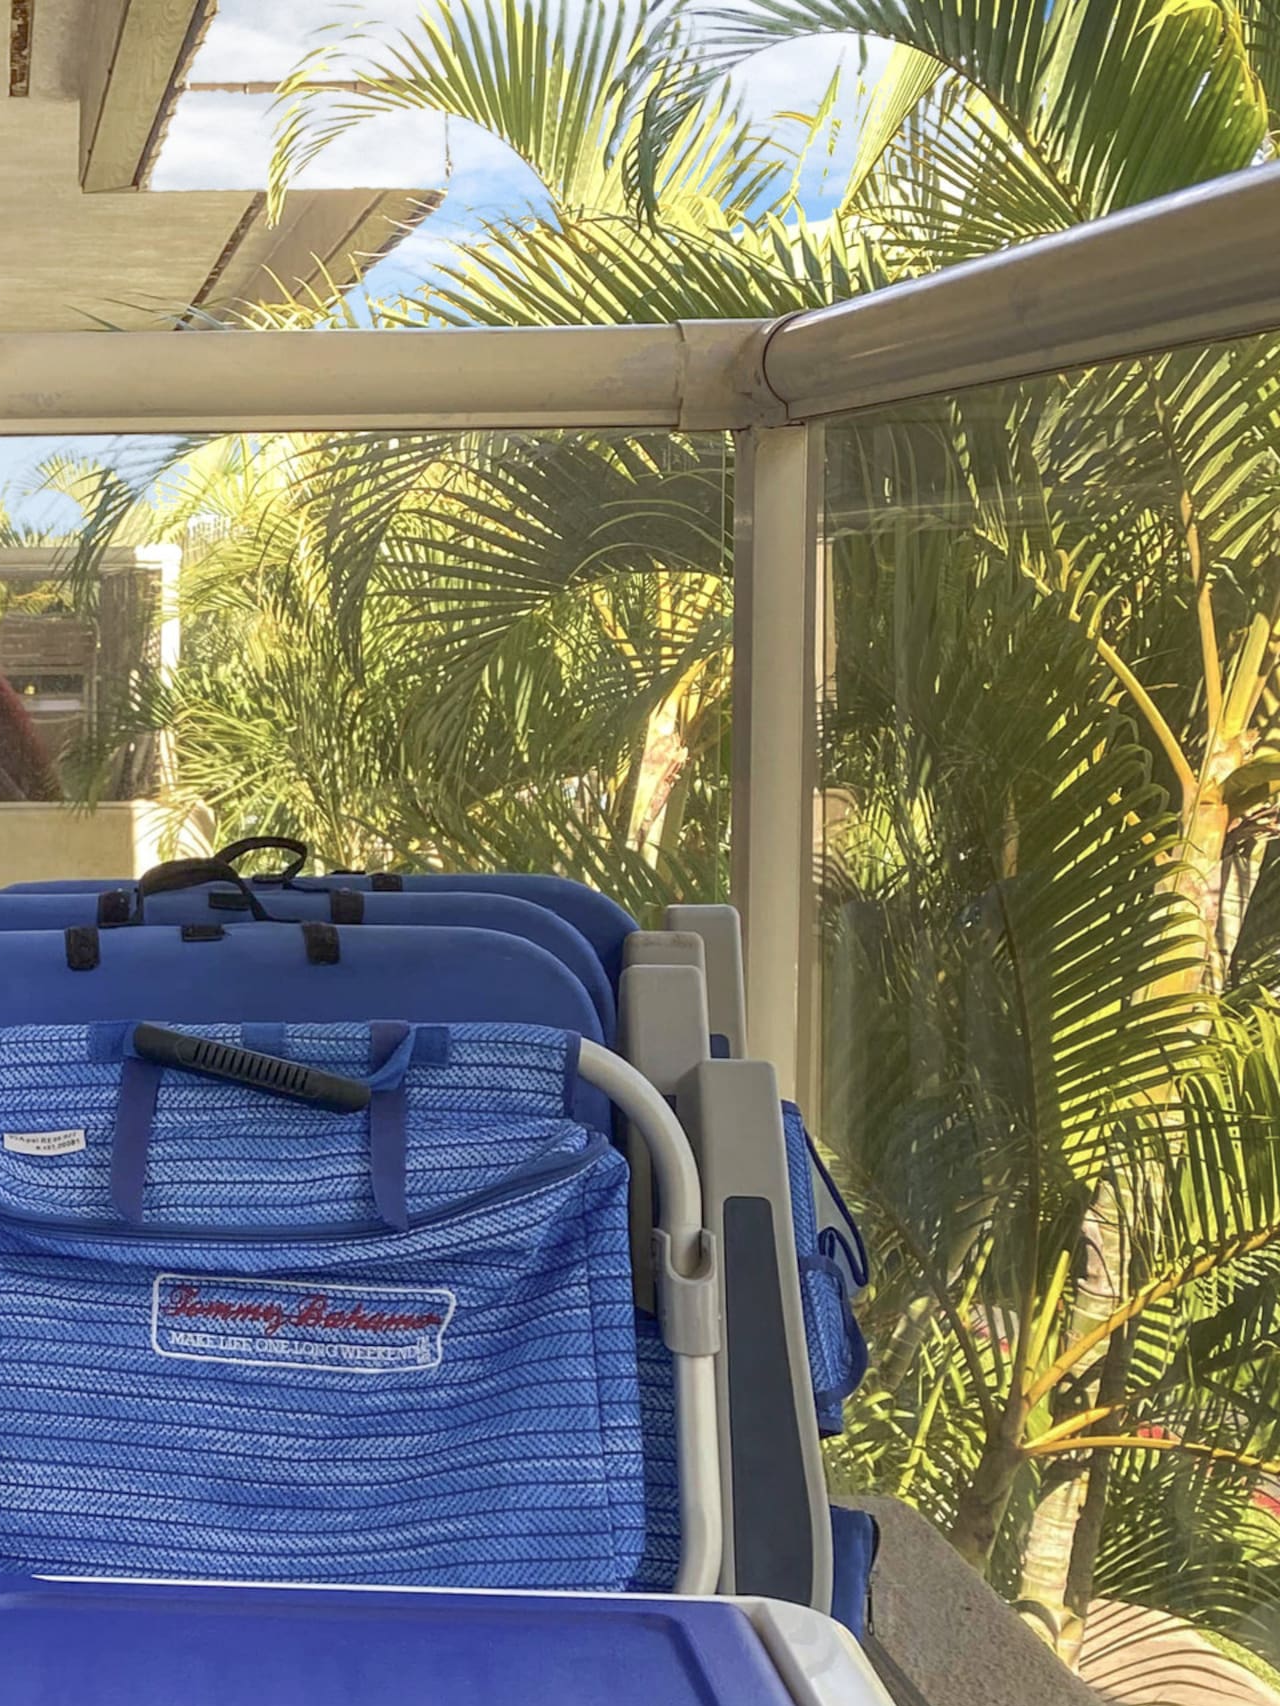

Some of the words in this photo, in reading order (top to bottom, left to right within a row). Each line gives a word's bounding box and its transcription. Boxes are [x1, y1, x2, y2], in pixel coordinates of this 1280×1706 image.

[160, 1285, 285, 1335] Tommy
[286, 1294, 443, 1331] Bahama
[170, 1332, 217, 1347] MAKE
[219, 1337, 253, 1350] LIFE
[256, 1339, 288, 1352] ONE
[341, 1346, 418, 1360] WEEKEND
